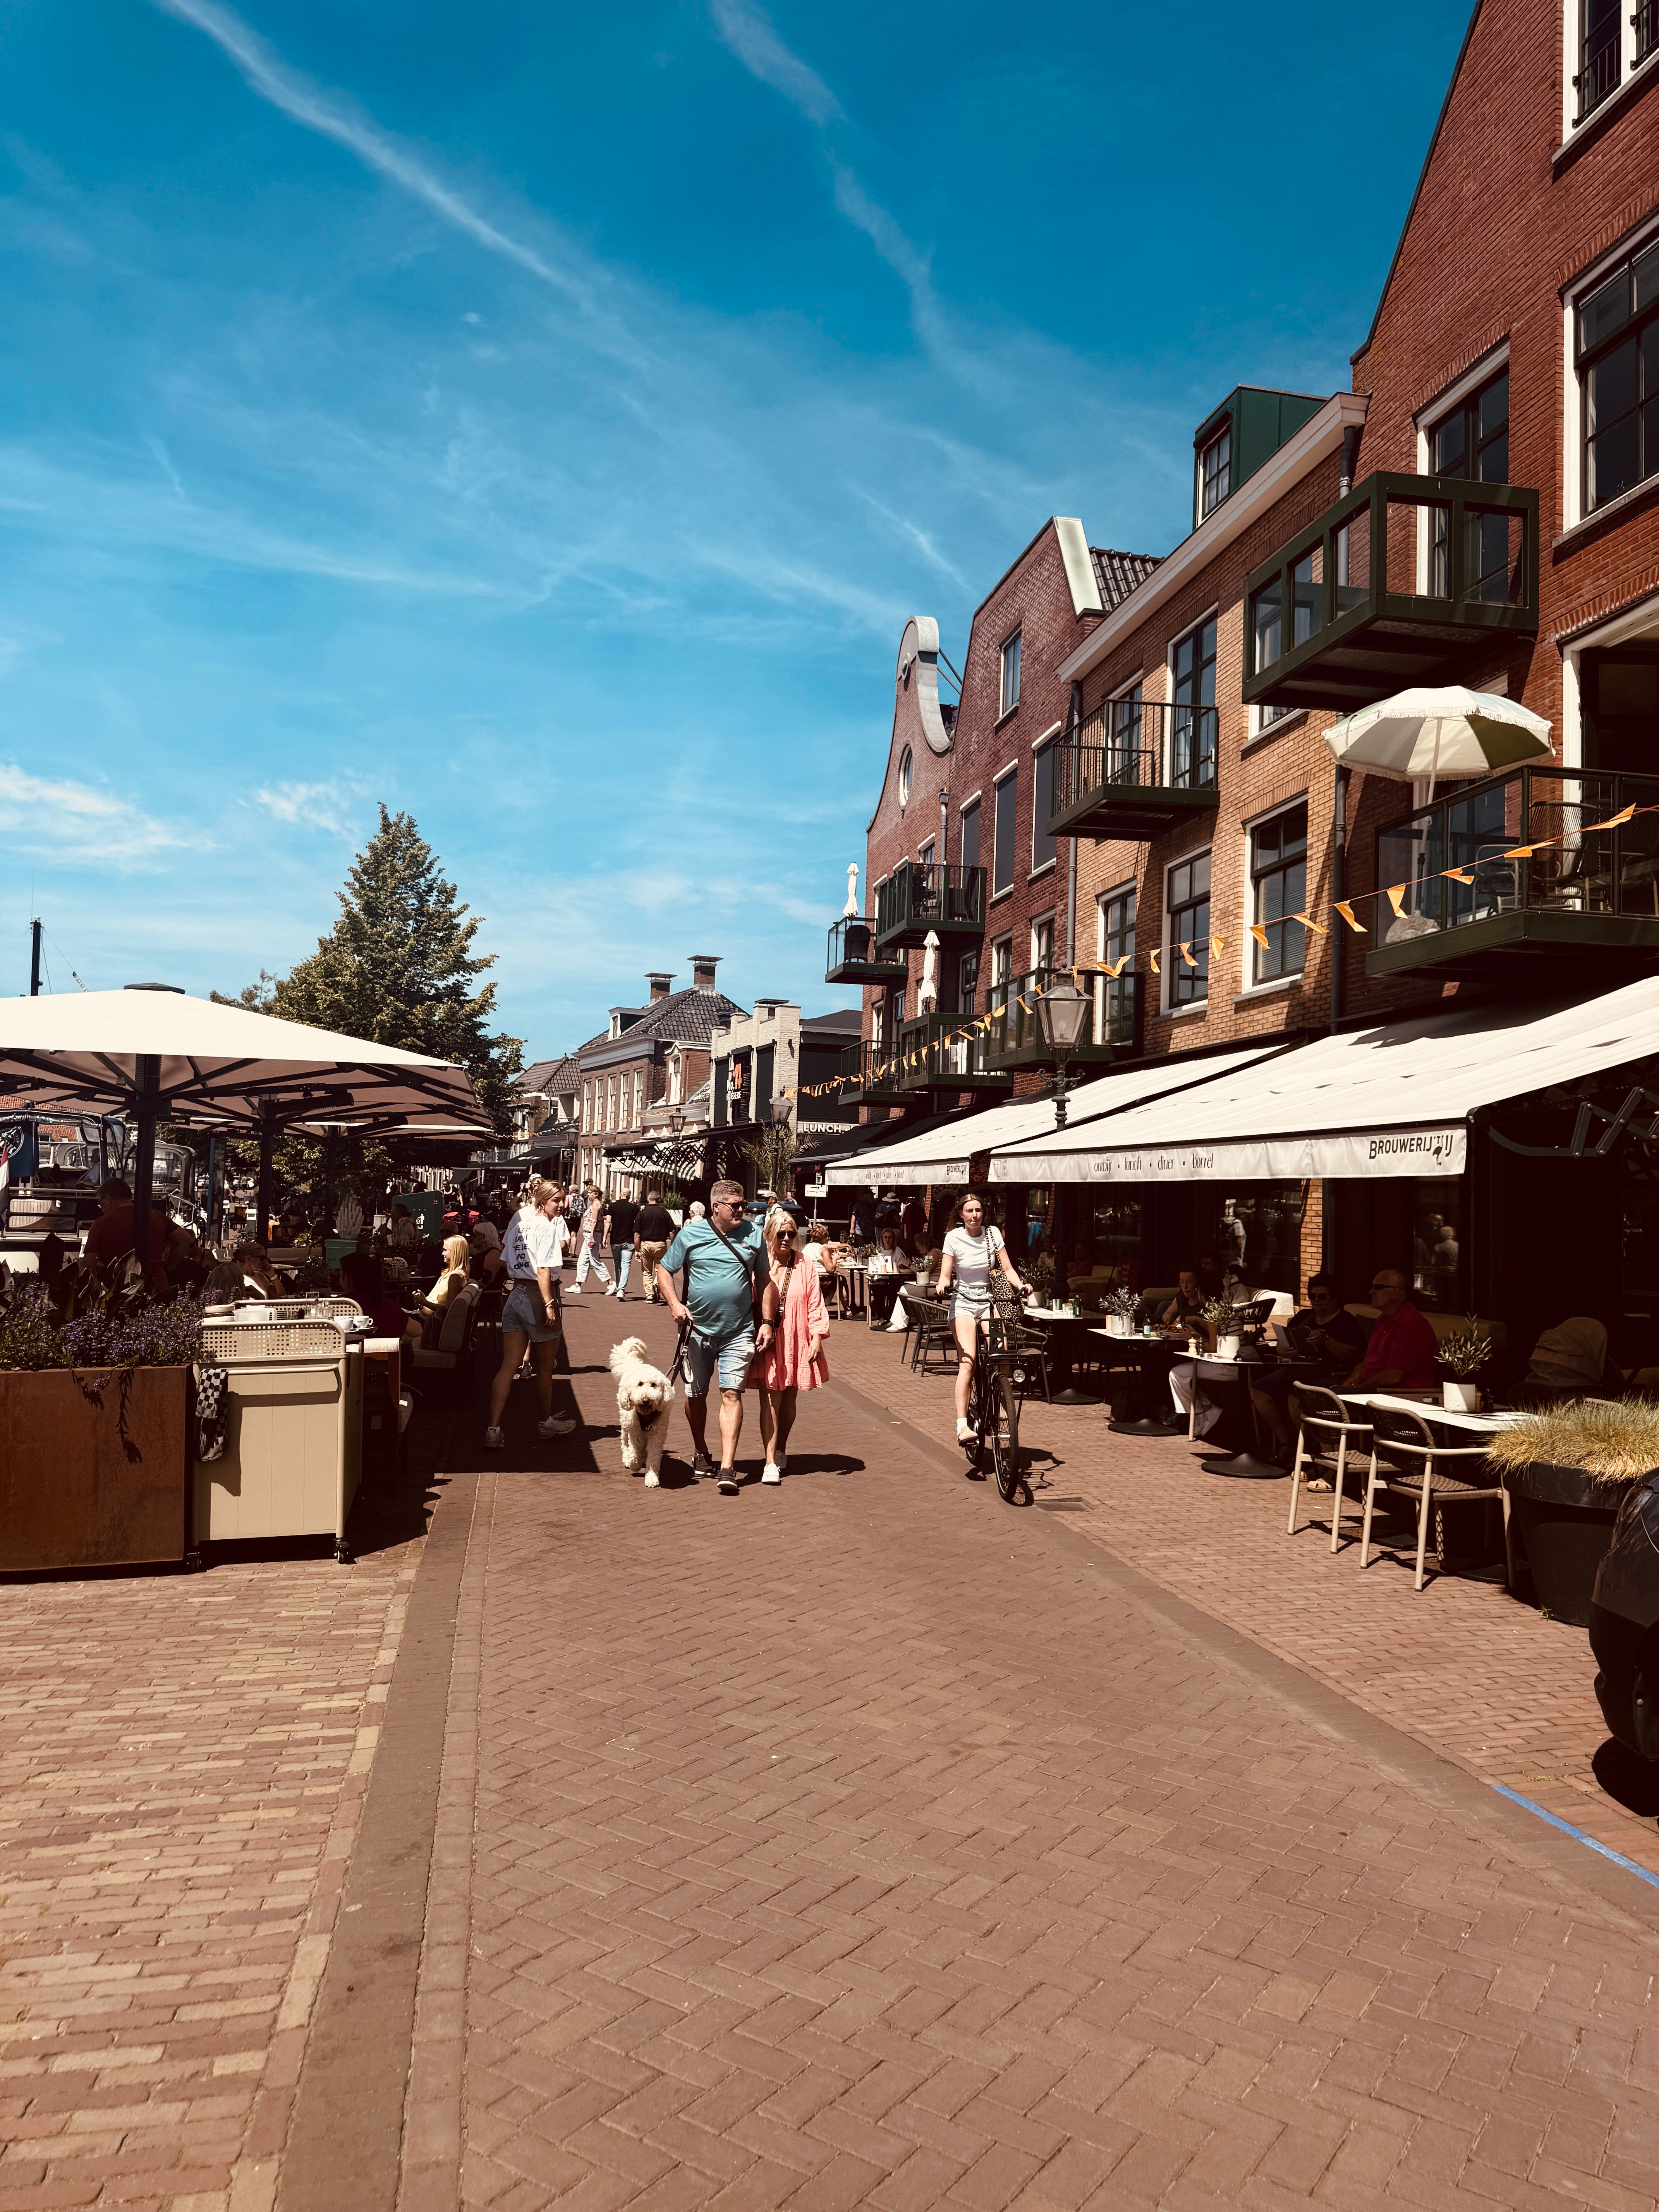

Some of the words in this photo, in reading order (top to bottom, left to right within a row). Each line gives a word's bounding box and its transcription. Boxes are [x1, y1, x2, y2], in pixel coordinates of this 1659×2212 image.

[803, 1123, 841, 1133] LUNCH
[1369, 1136, 1432, 1159] BROUWERIJ
[1094, 1158, 1112, 1175] ontbijt
[1125, 1156, 1142, 1171] lunch
[1158, 1155, 1175, 1170] diner
[1192, 1152, 1214, 1169] borrel
